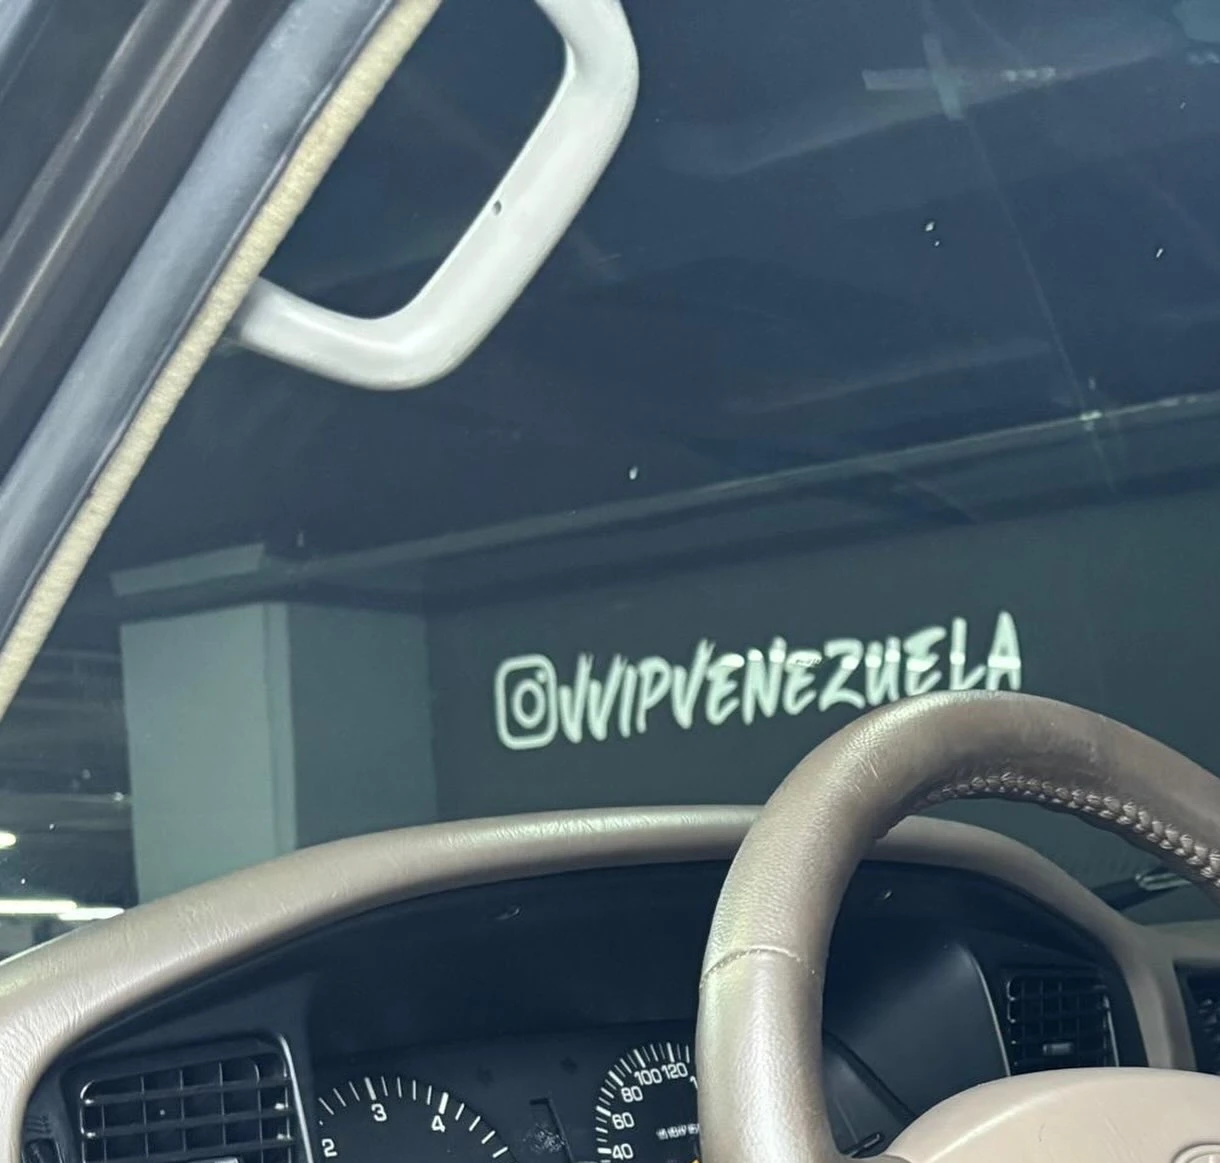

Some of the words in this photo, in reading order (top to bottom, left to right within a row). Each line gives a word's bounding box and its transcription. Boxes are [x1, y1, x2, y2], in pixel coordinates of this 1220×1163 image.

[634, 1068, 662, 1086] 100
[661, 1062, 688, 1079] 120
[621, 1086, 643, 1102] 80
[371, 1103, 388, 1122] 3
[612, 1112, 635, 1129] 60
[431, 1115, 446, 1132] 4
[321, 1138, 338, 1157] 2
[612, 1143, 633, 1160] 40
